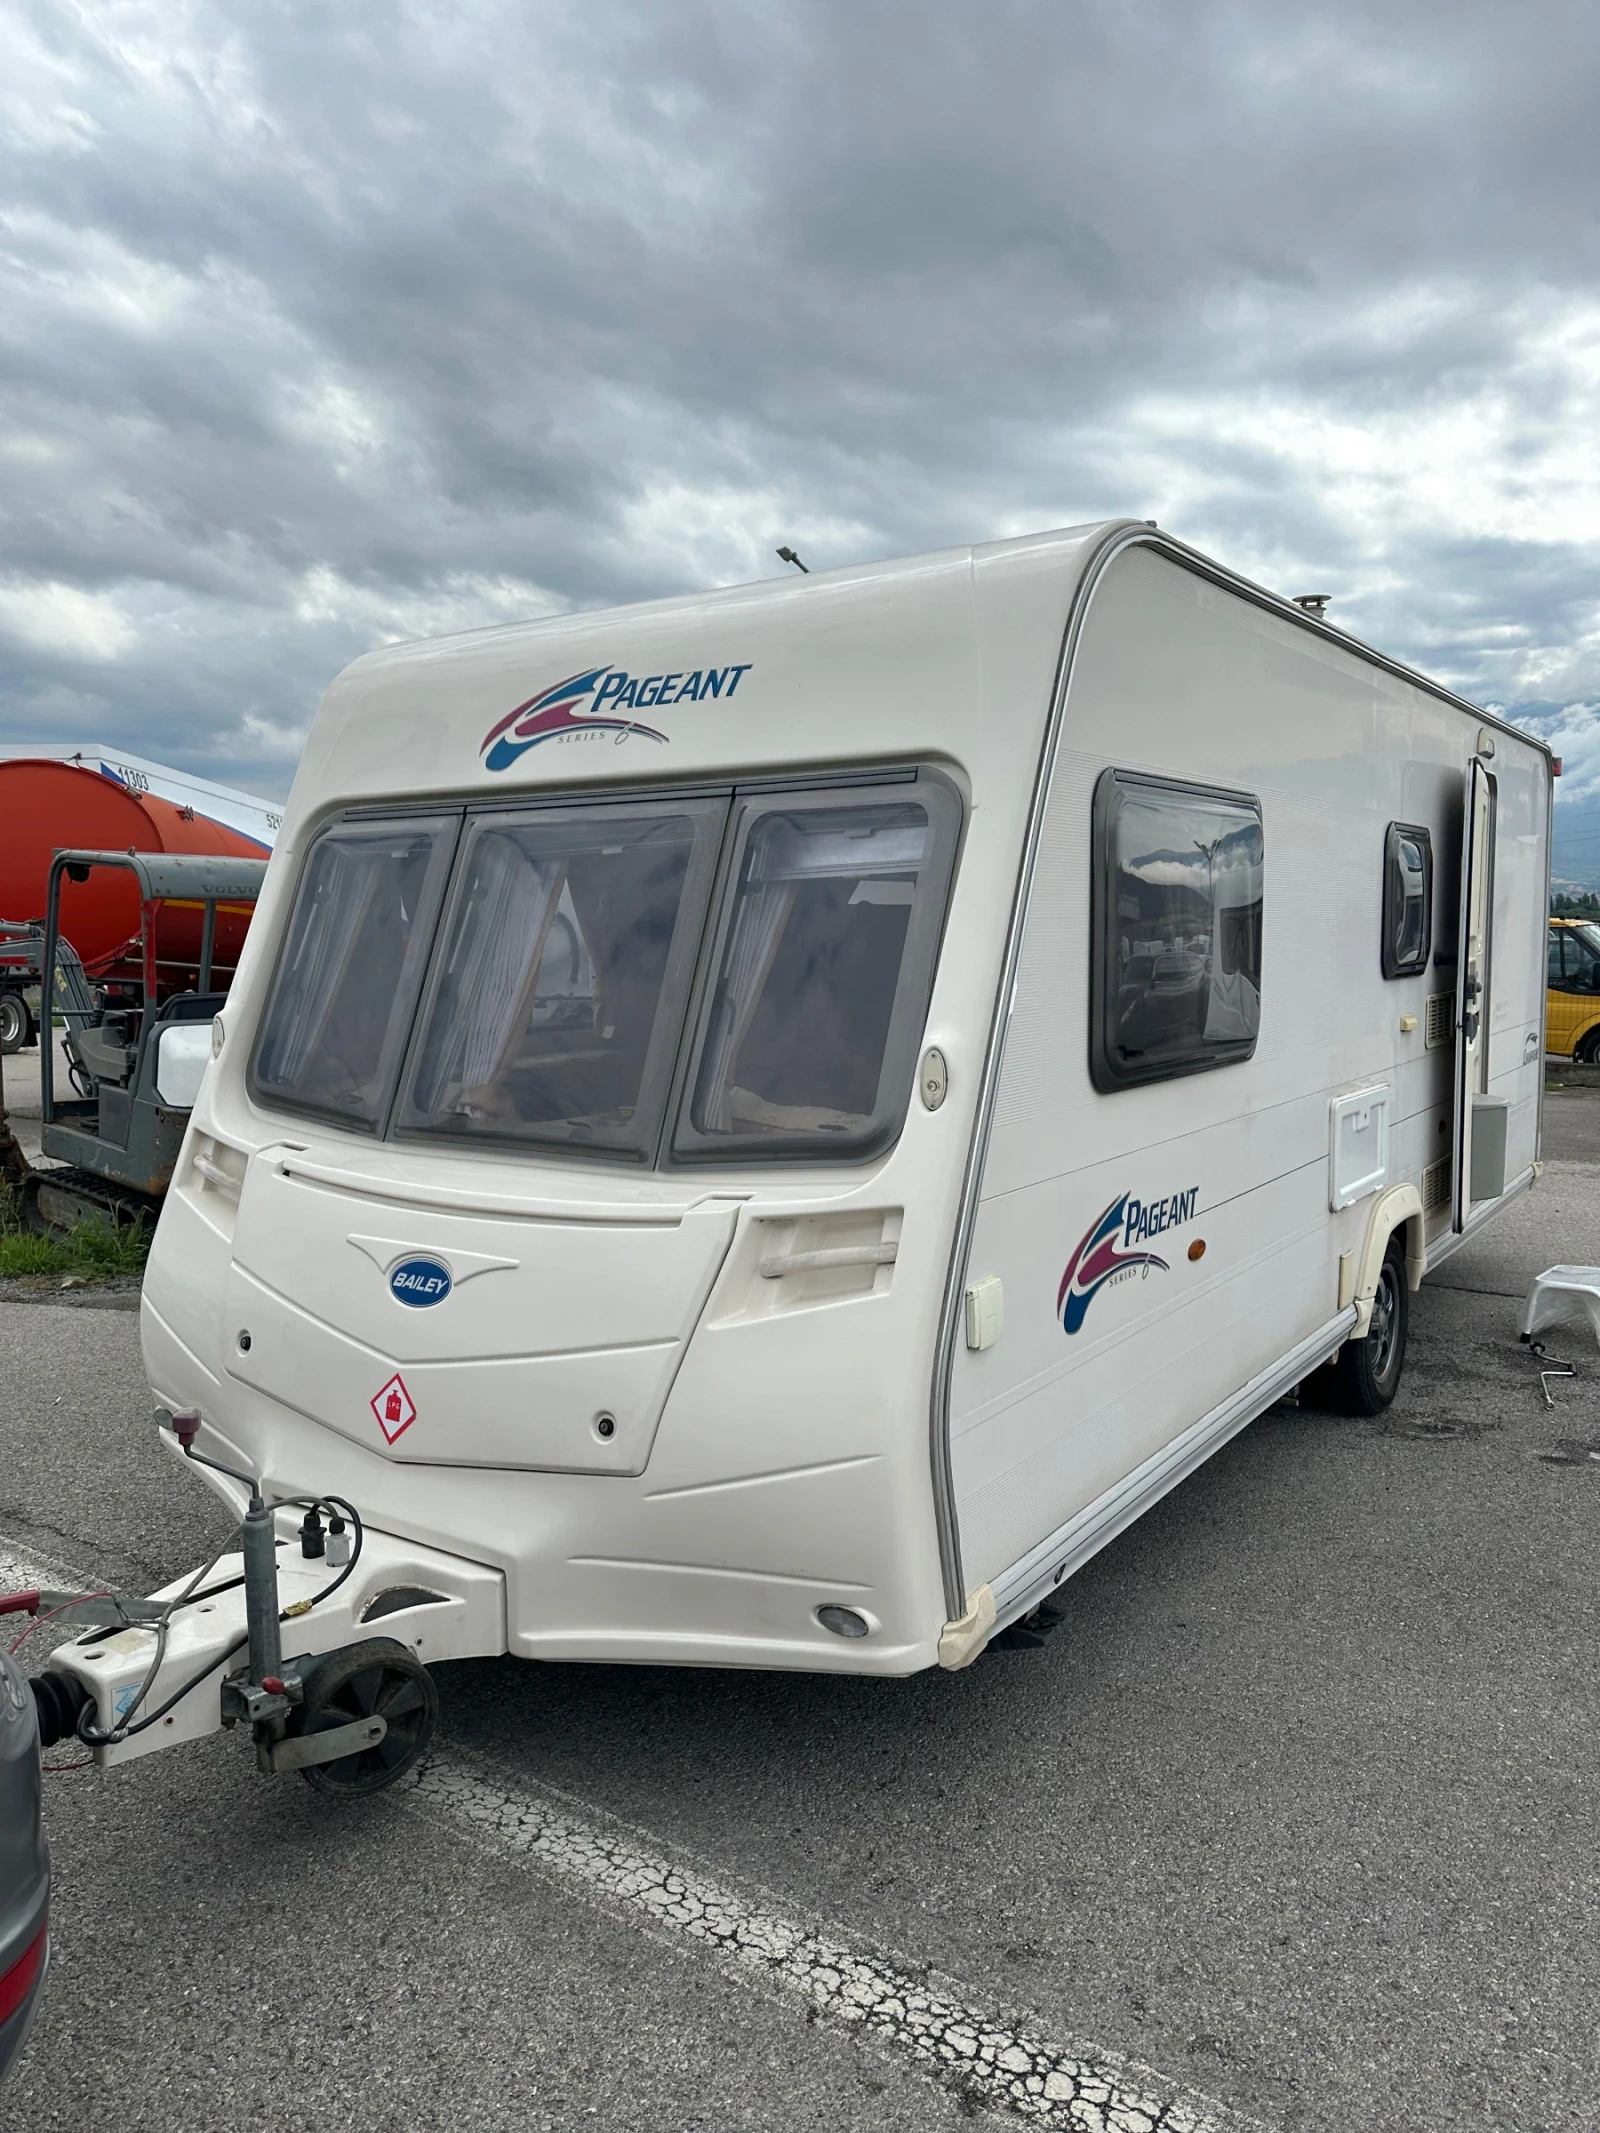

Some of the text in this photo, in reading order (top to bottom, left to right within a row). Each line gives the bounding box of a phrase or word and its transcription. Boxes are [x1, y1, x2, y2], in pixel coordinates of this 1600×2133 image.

[590, 663, 754, 713] PAGEANT
[557, 721, 635, 745] SERIES 6
[118, 766, 149, 791] 11303
[265, 813, 283, 829] 521
[200, 884, 260, 895] VOLVO
[1124, 1185, 1200, 1248] PAGEANT
[1109, 1253, 1151, 1288] SERIES 6
[392, 1272, 449, 1294] BAILEY
[388, 1400, 400, 1410] LPG
